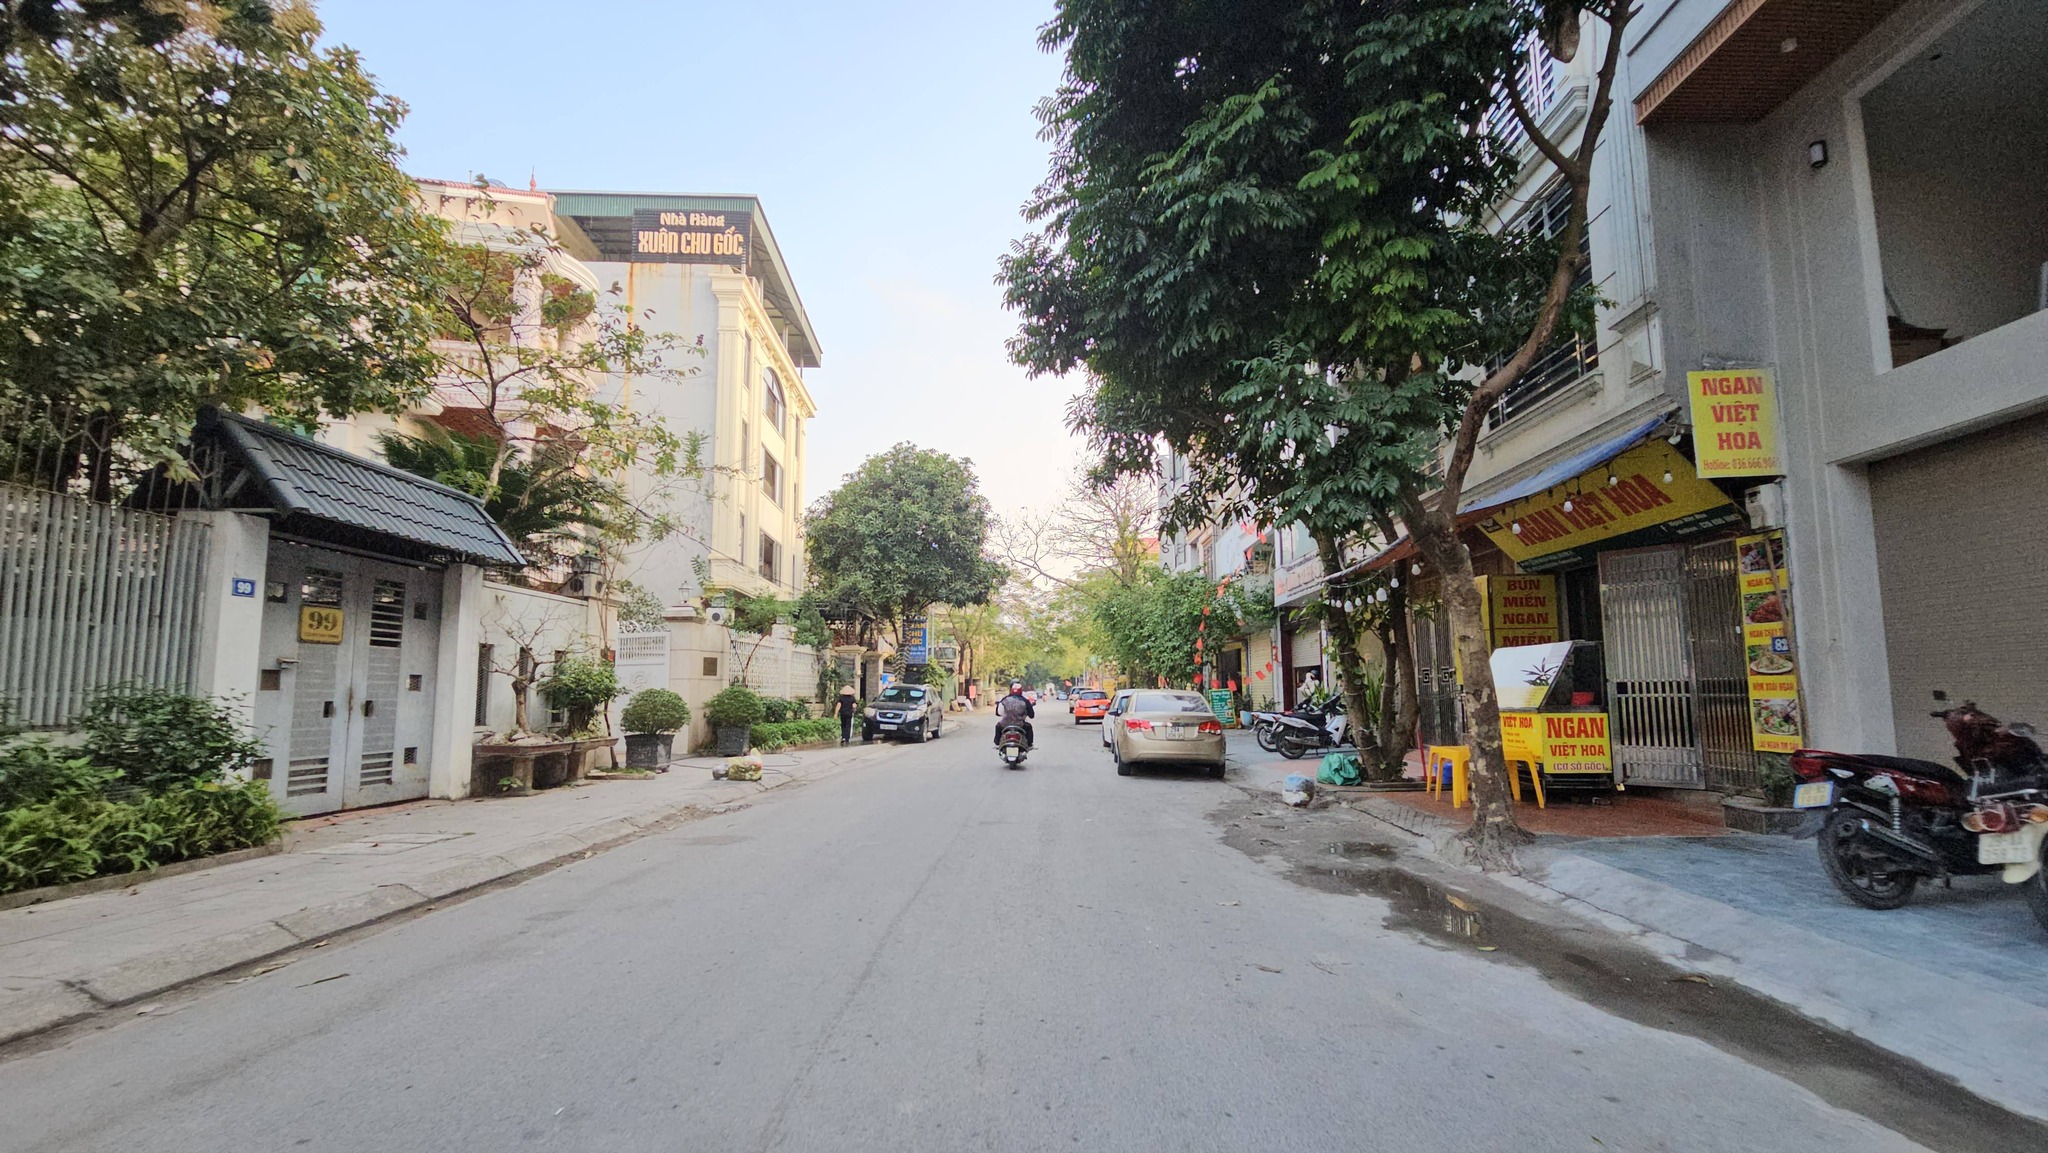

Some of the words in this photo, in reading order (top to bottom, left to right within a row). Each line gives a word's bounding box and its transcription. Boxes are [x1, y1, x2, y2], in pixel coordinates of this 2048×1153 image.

[660, 212, 687, 226] Nhà
[690, 212, 725, 227] Hàng
[638, 228, 679, 254] XUÂN
[681, 231, 711, 255] CHU
[713, 226, 744, 256] GỐC
[1701, 377, 1764, 396] NGAN
[1711, 400, 1759, 426] VIỆT
[1717, 431, 1762, 451] HOA
[1600, 473, 1674, 517] HOA
[237, 582, 252, 594] 99
[1507, 577, 1541, 591] BÚN
[308, 611, 338, 631] 99
[1502, 613, 1550, 625] NGAN
[1774, 638, 1789, 652] 82
[1519, 716, 1534, 729] HOA
[1546, 717, 1605, 739] NGAN
[1550, 741, 1577, 760] VIỆT
[1581, 744, 1606, 757] HOA
